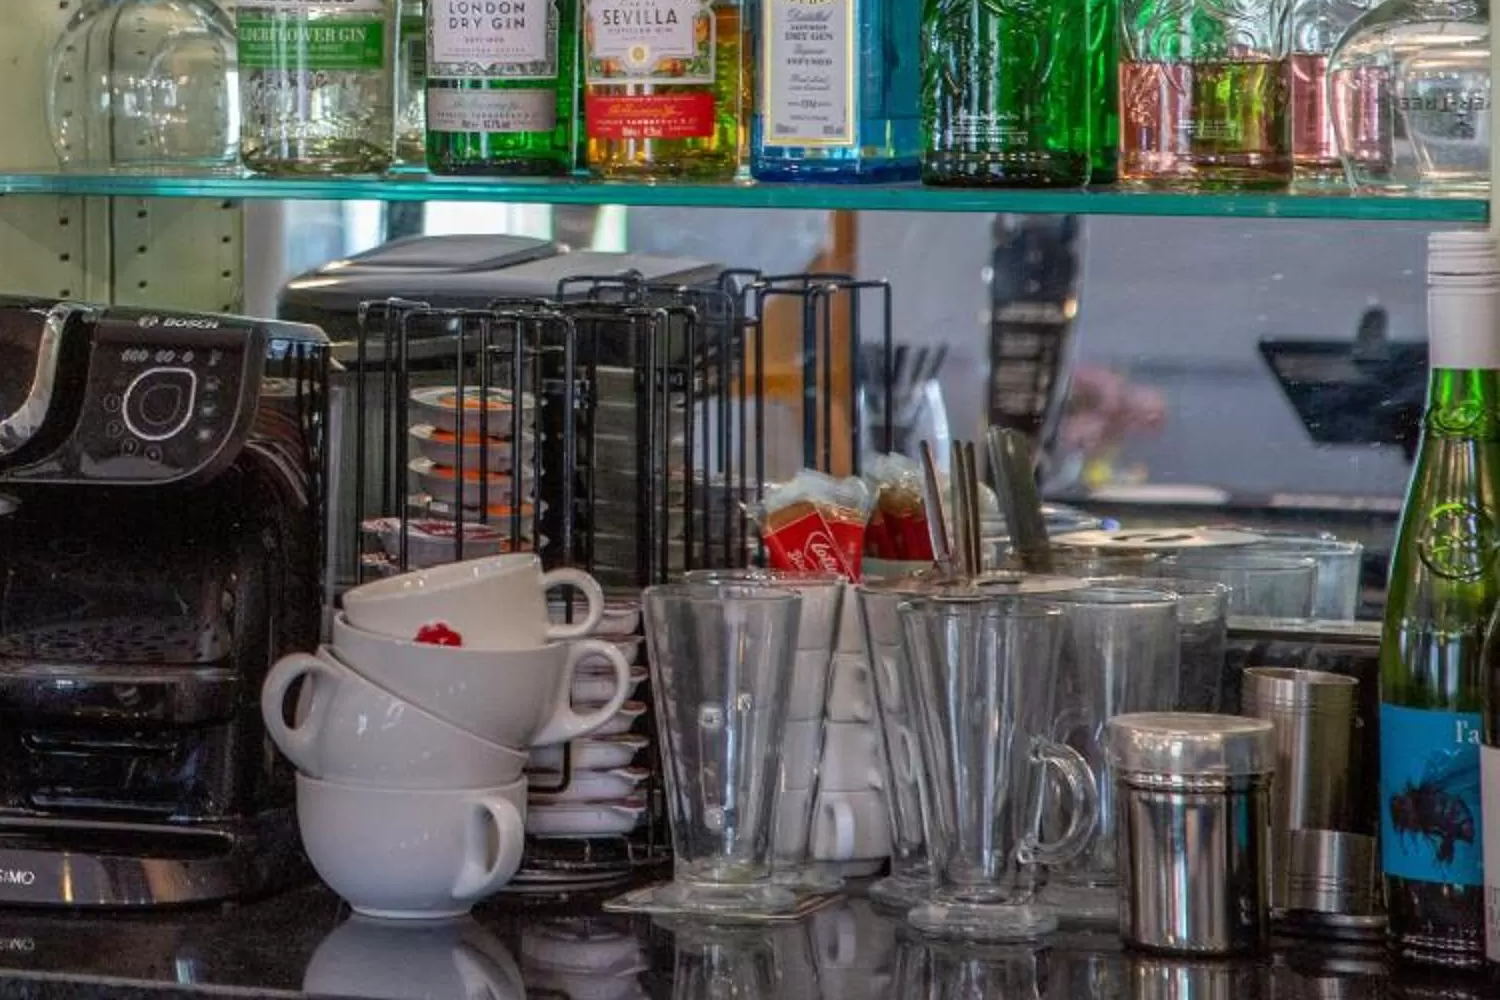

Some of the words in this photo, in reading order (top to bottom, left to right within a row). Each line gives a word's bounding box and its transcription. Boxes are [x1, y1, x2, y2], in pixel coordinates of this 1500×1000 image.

[448, 1, 525, 15] LONDON
[448, 17, 483, 30] DRY
[491, 17, 525, 30] GIN
[603, 8, 678, 25] SEVILLA
[239, 26, 337, 42] LDERFLOWER
[339, 26, 367, 42] GIN
[163, 318, 220, 329] BOSCH
